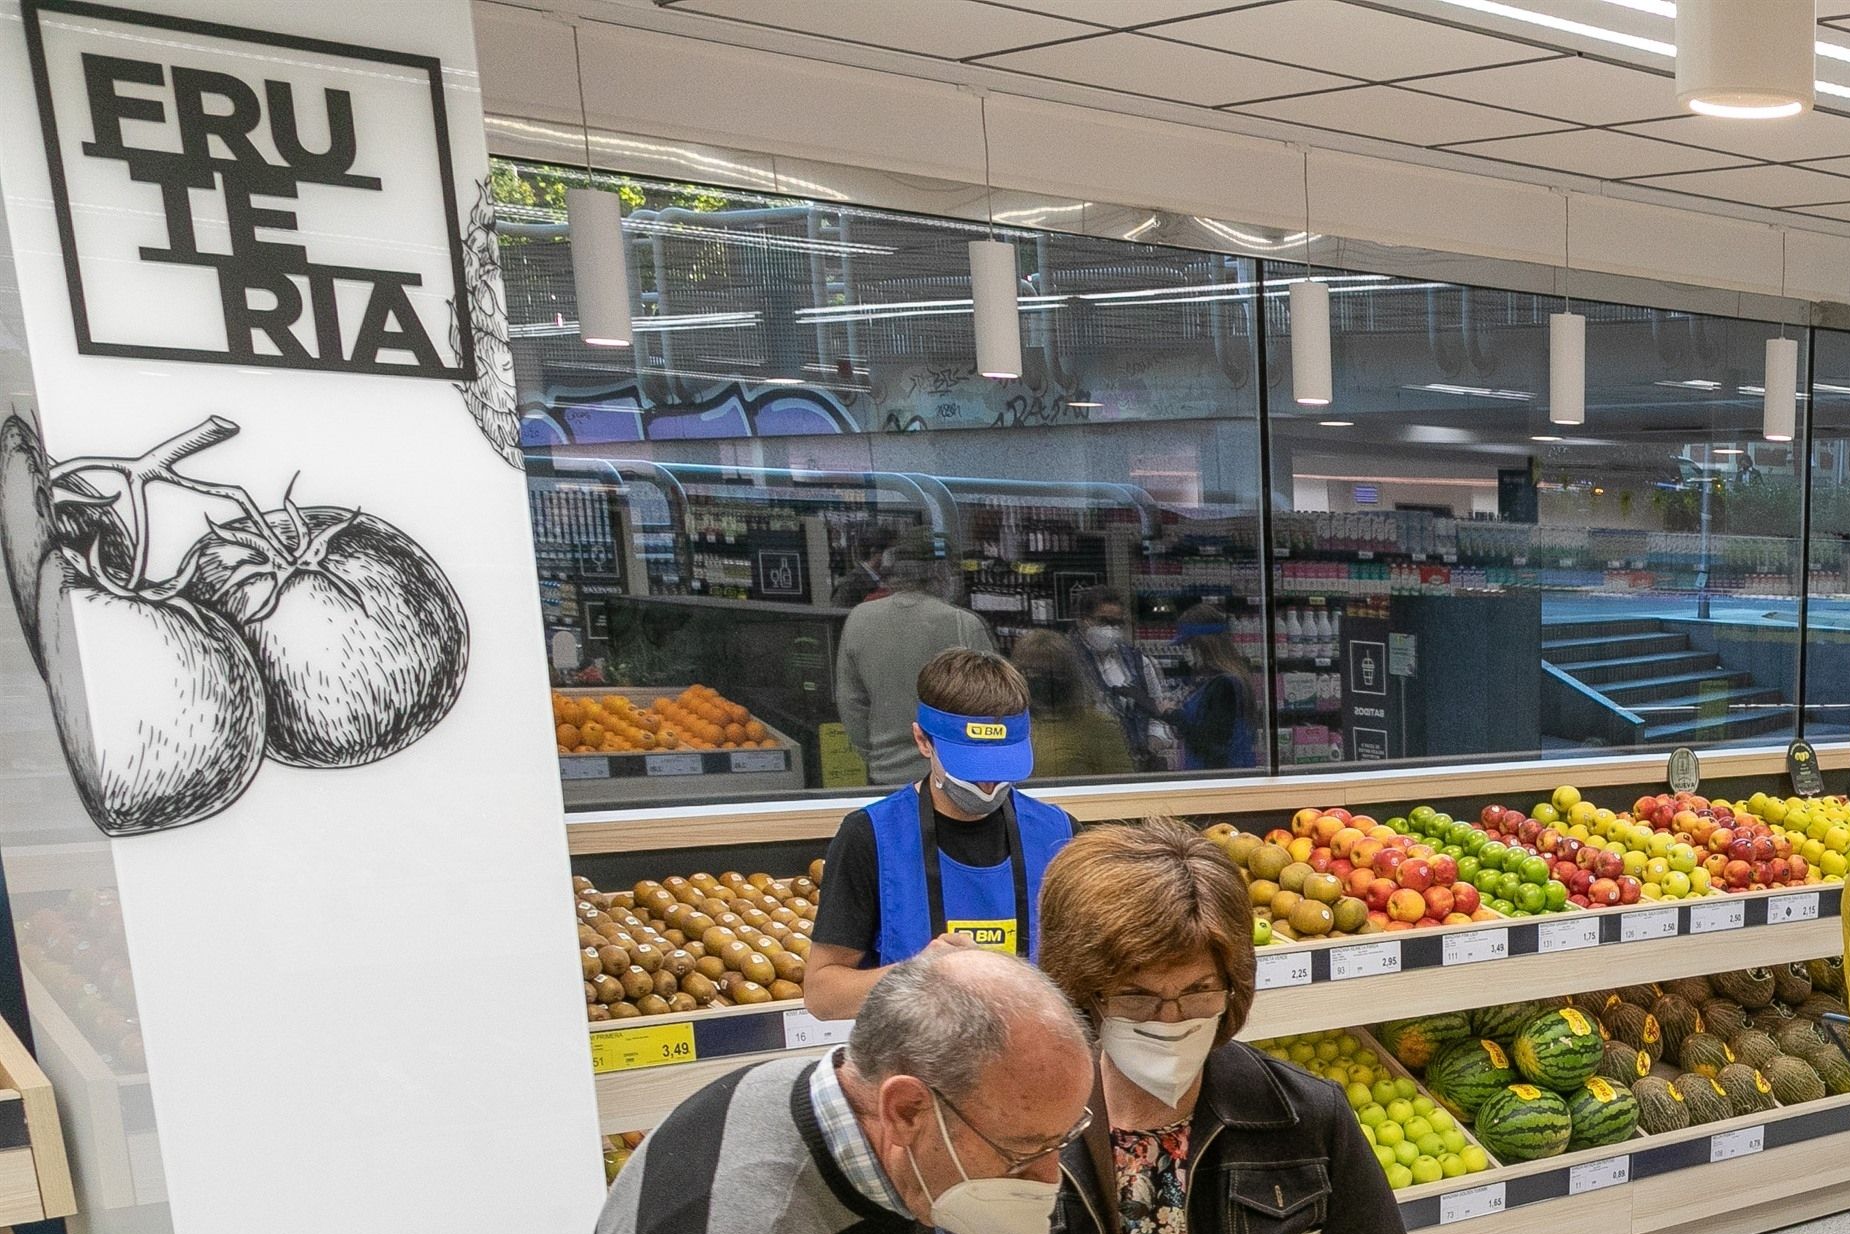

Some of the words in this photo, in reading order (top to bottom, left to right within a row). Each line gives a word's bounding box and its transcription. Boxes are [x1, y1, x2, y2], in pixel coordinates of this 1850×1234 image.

[82, 52, 360, 182] FRU
[129, 160, 308, 263] TE
[217, 264, 447, 370] RIA
[984, 726, 1003, 737] BM
[1674, 781, 1696, 789] NUEVA
[1803, 905, 1816, 916] 2,15
[975, 930, 1003, 943] BM
[1583, 931, 1596, 942] 1,75
[596, 1032, 625, 1041] PRIMERA
[795, 1031, 807, 1042] 16
[1488, 1197, 1502, 1209] 1,65
